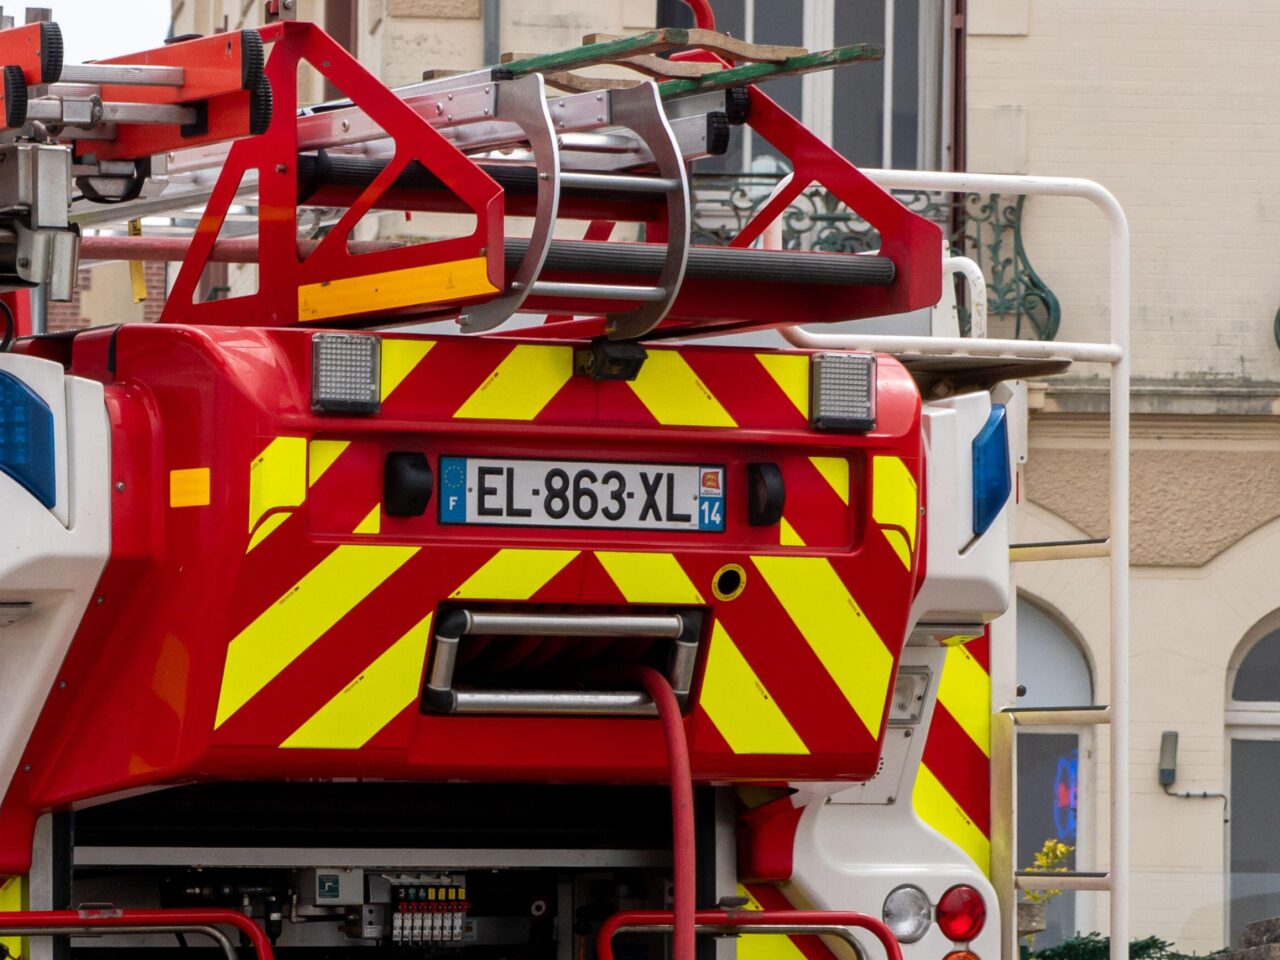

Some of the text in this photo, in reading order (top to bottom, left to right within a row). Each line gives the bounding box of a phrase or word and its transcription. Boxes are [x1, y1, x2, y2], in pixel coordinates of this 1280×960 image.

[448, 496, 458, 511] F
[477, 466, 692, 523] EL-863-XL
[700, 500, 721, 525] 14
